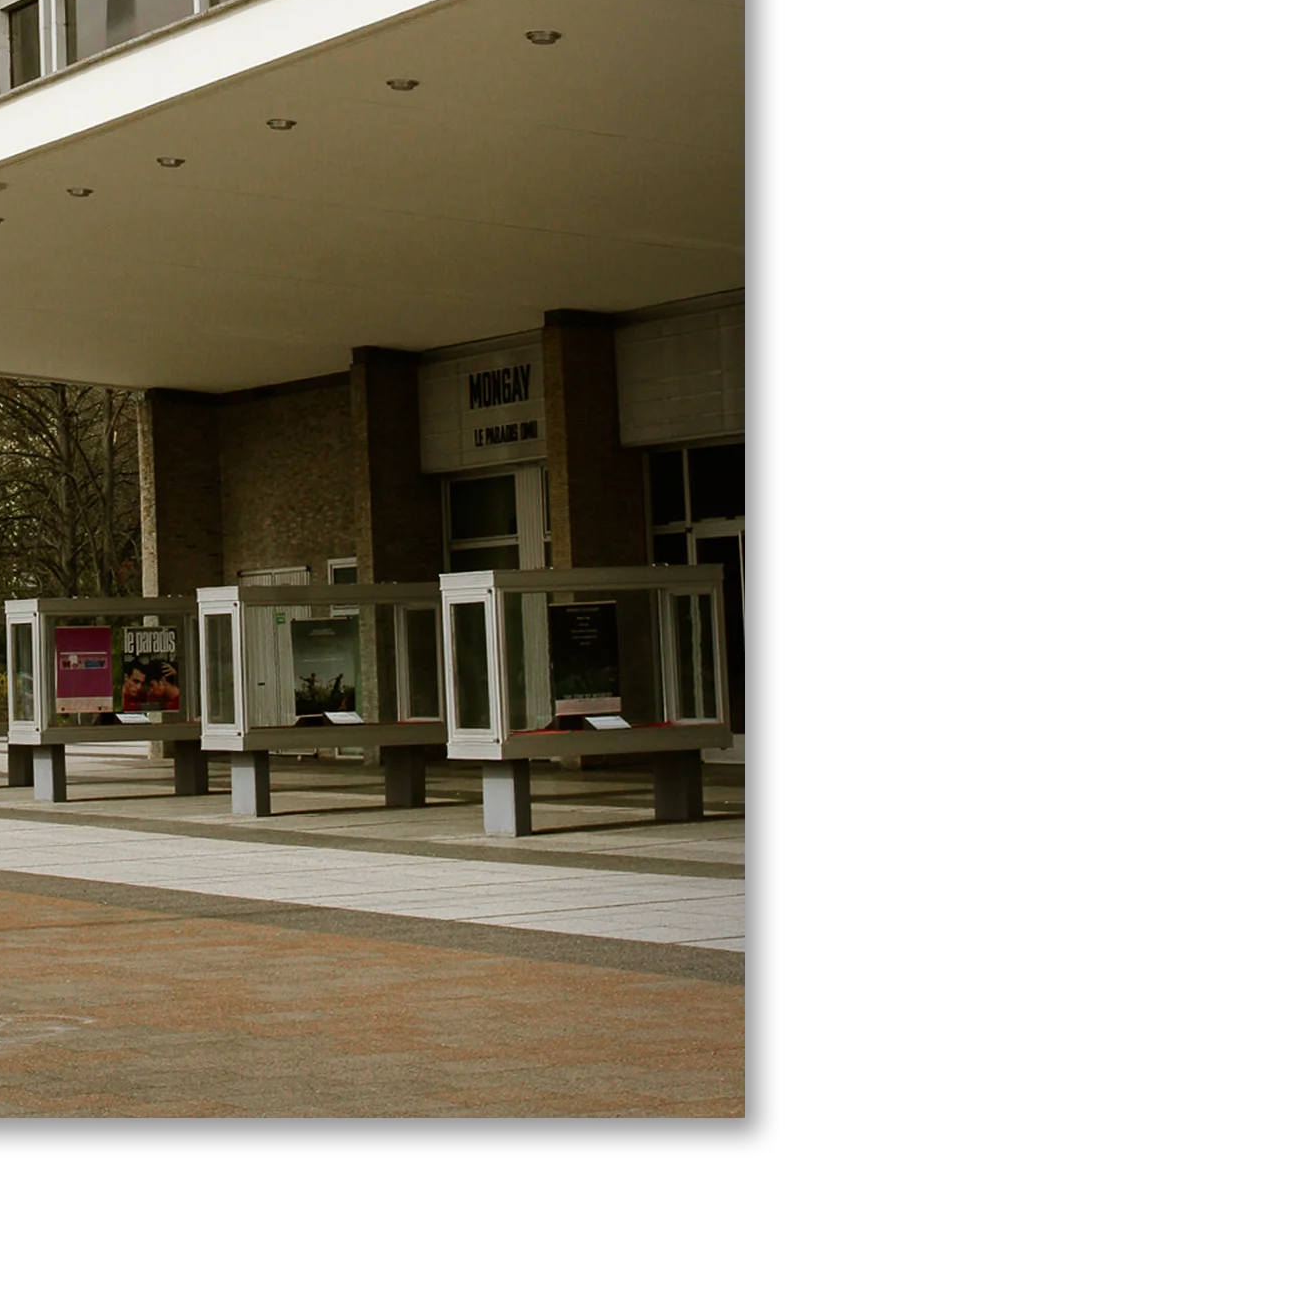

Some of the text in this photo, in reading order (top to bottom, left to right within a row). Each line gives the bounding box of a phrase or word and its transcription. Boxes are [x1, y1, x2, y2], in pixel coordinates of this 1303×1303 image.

[469, 363, 531, 410] MONGAY
[474, 428, 484, 447] LE
[485, 423, 519, 446] PARADIS
[124, 627, 176, 656] le paradis
